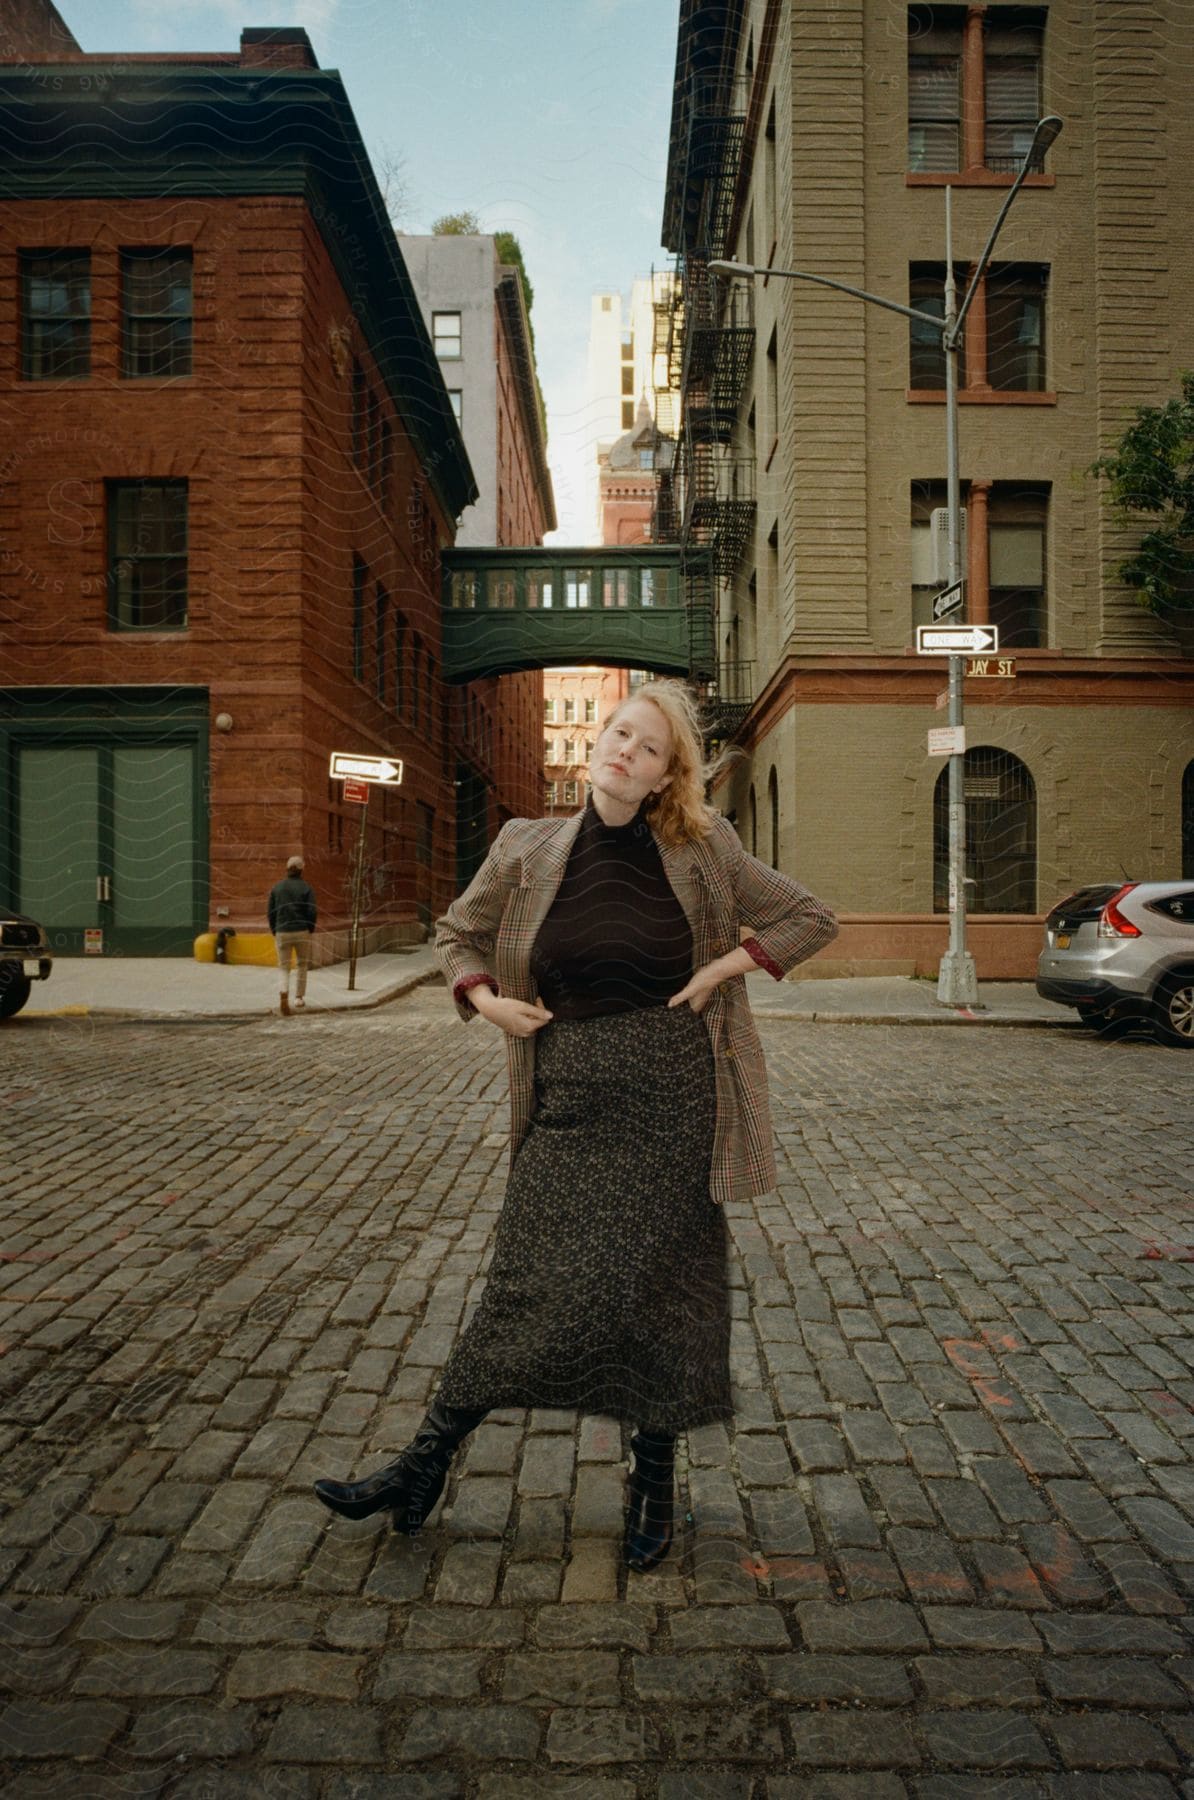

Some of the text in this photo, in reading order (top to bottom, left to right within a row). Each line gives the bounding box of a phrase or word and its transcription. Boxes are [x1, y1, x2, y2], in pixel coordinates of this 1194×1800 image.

[929, 634, 984, 645] ONE WAY
[968, 659, 1013, 675] JAY ST
